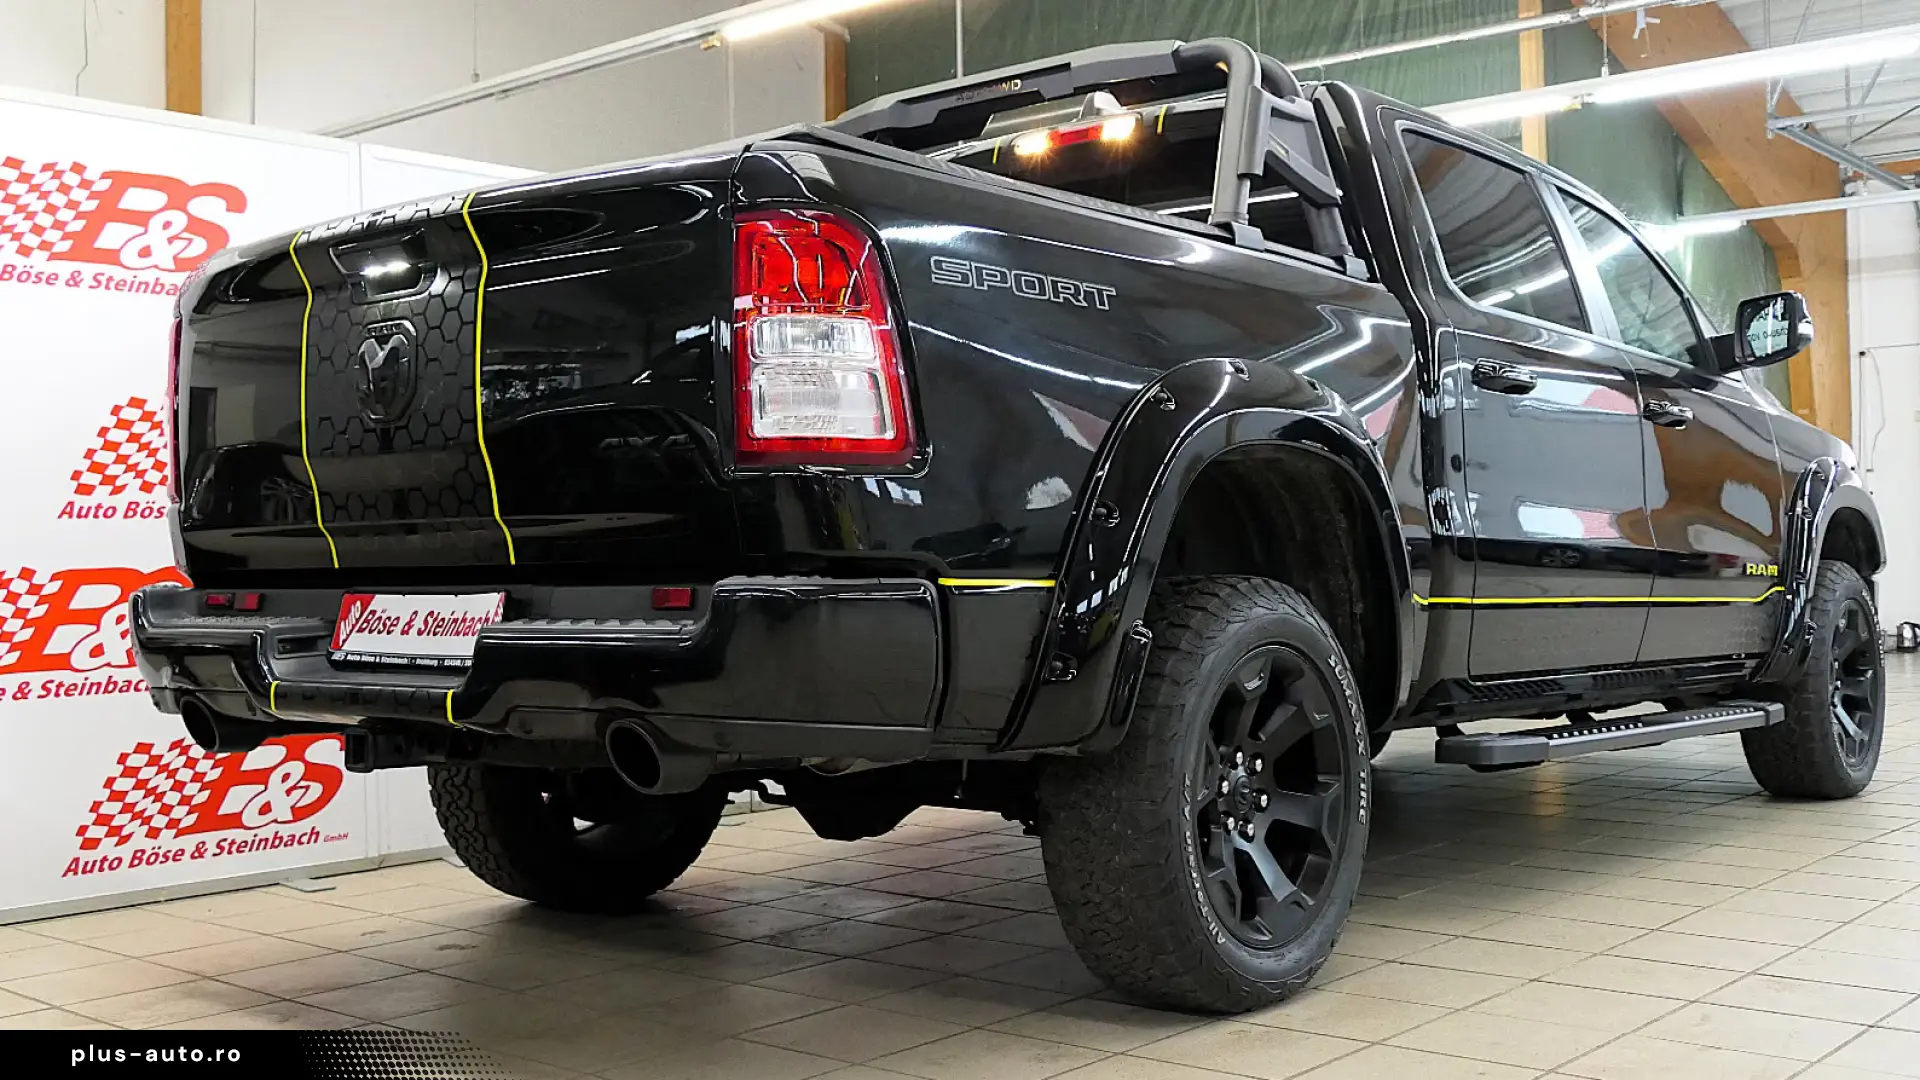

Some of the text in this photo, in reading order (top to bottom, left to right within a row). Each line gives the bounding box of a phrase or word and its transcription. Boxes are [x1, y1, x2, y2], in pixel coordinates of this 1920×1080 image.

[0, 263, 60, 286] Böse
[64, 270, 85, 288] &
[930, 255, 1116, 311] SPORT
[57, 500, 168, 519] Auto Bös
[1745, 562, 1778, 577] RAM
[339, 600, 362, 646] Auto
[356, 608, 400, 635] Böse
[400, 610, 418, 636] &
[416, 610, 491, 637] Steinbach
[11, 681, 32, 701] &
[1358, 769, 1367, 825] TIRE
[61, 825, 349, 878] Auto Böse & Steinbach GmbH
